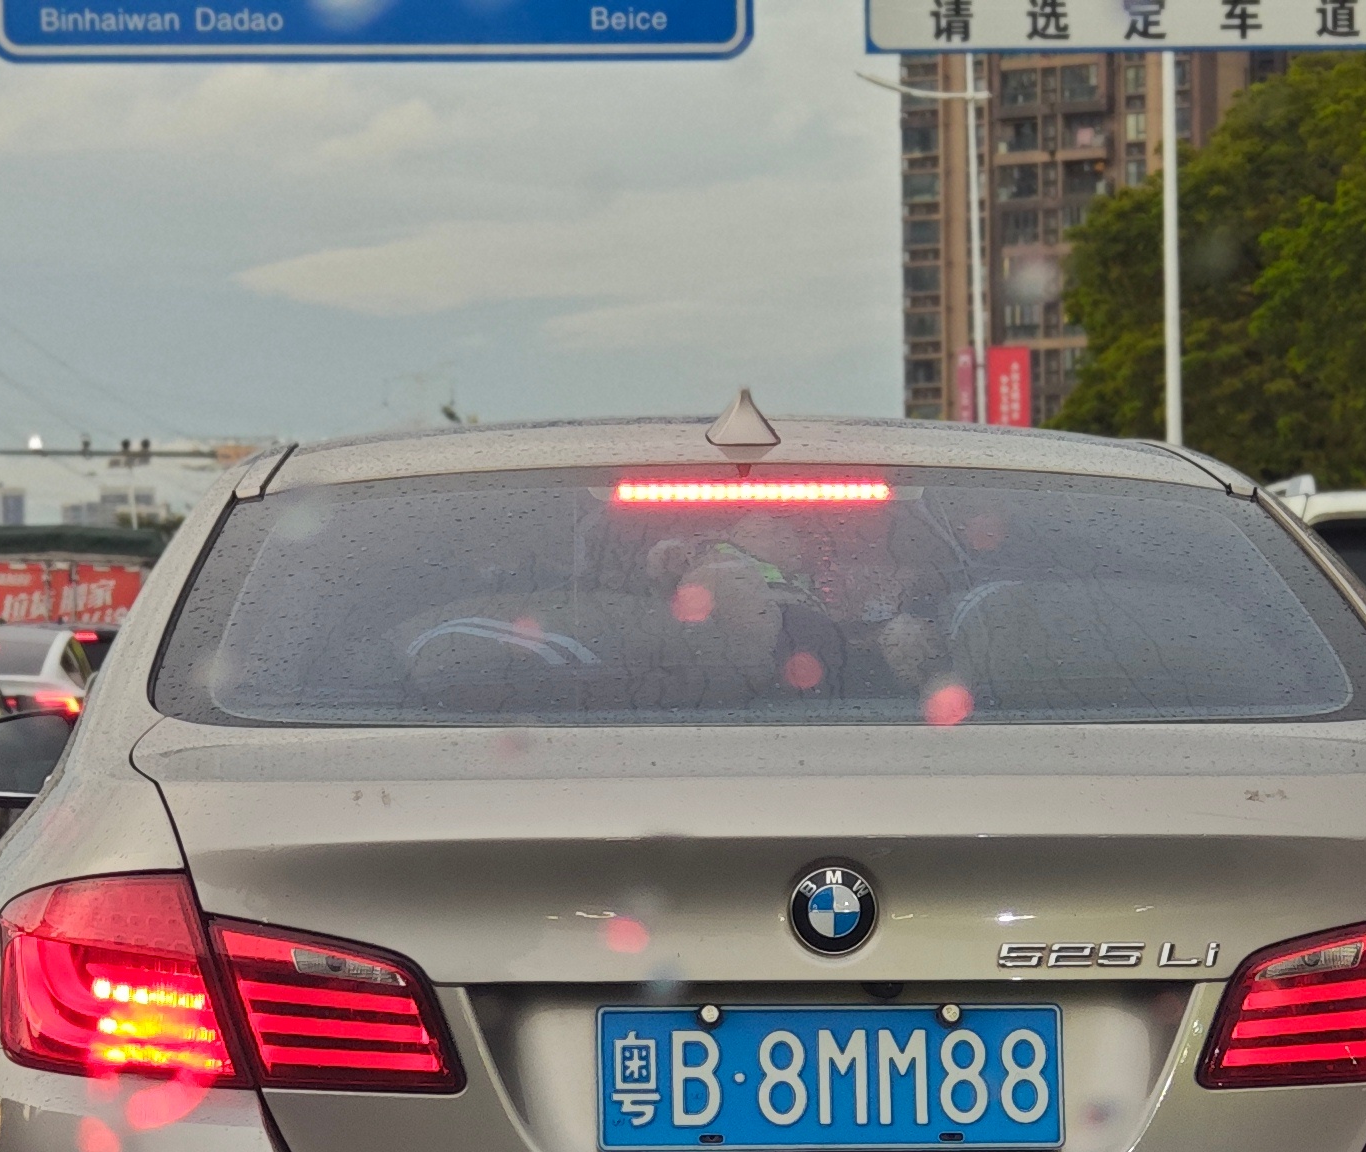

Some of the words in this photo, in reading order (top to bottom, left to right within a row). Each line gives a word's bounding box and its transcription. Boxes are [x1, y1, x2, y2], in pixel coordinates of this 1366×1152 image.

[40, 7, 180, 32] Binhaiwan
[195, 6, 284, 32] Dadao
[591, 6, 668, 31] Beice
[799, 870, 870, 898] BMW
[997, 942, 1147, 968] 525
[610, 1028, 1051, 1127] 粤B·8MM88
